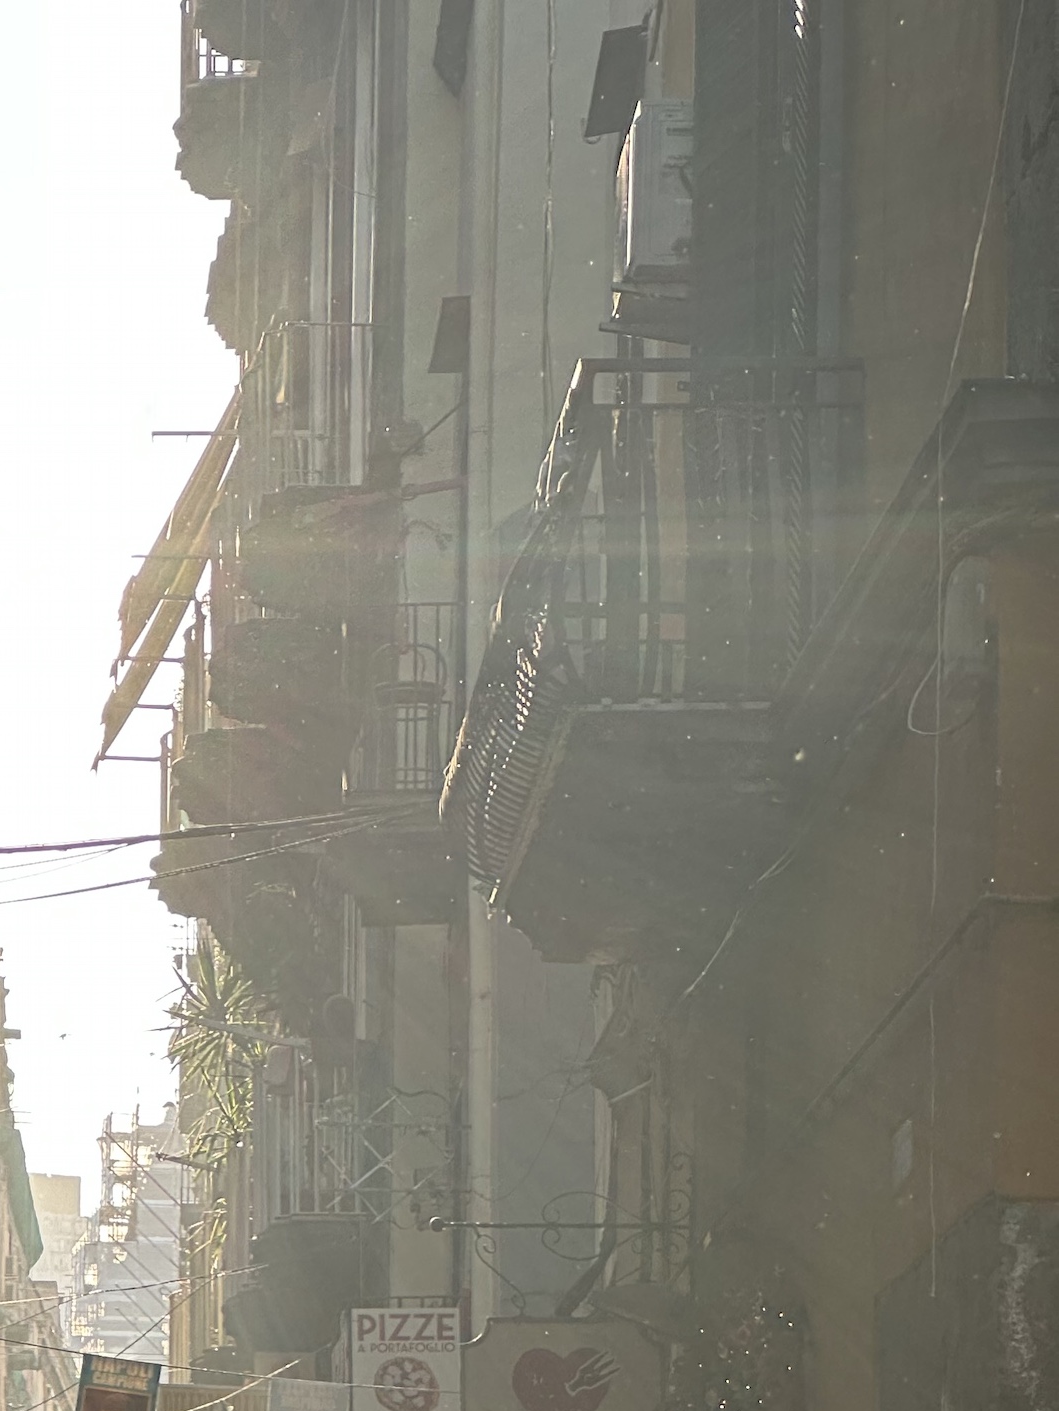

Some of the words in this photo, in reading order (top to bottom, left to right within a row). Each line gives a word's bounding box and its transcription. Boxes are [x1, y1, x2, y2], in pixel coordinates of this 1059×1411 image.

[357, 1313, 455, 1341] PIZZE
[357, 1342, 366, 1353] A
[370, 1342, 455, 1353] PORTAFOGLIO
[91, 1357, 154, 1379] NAPOLI
